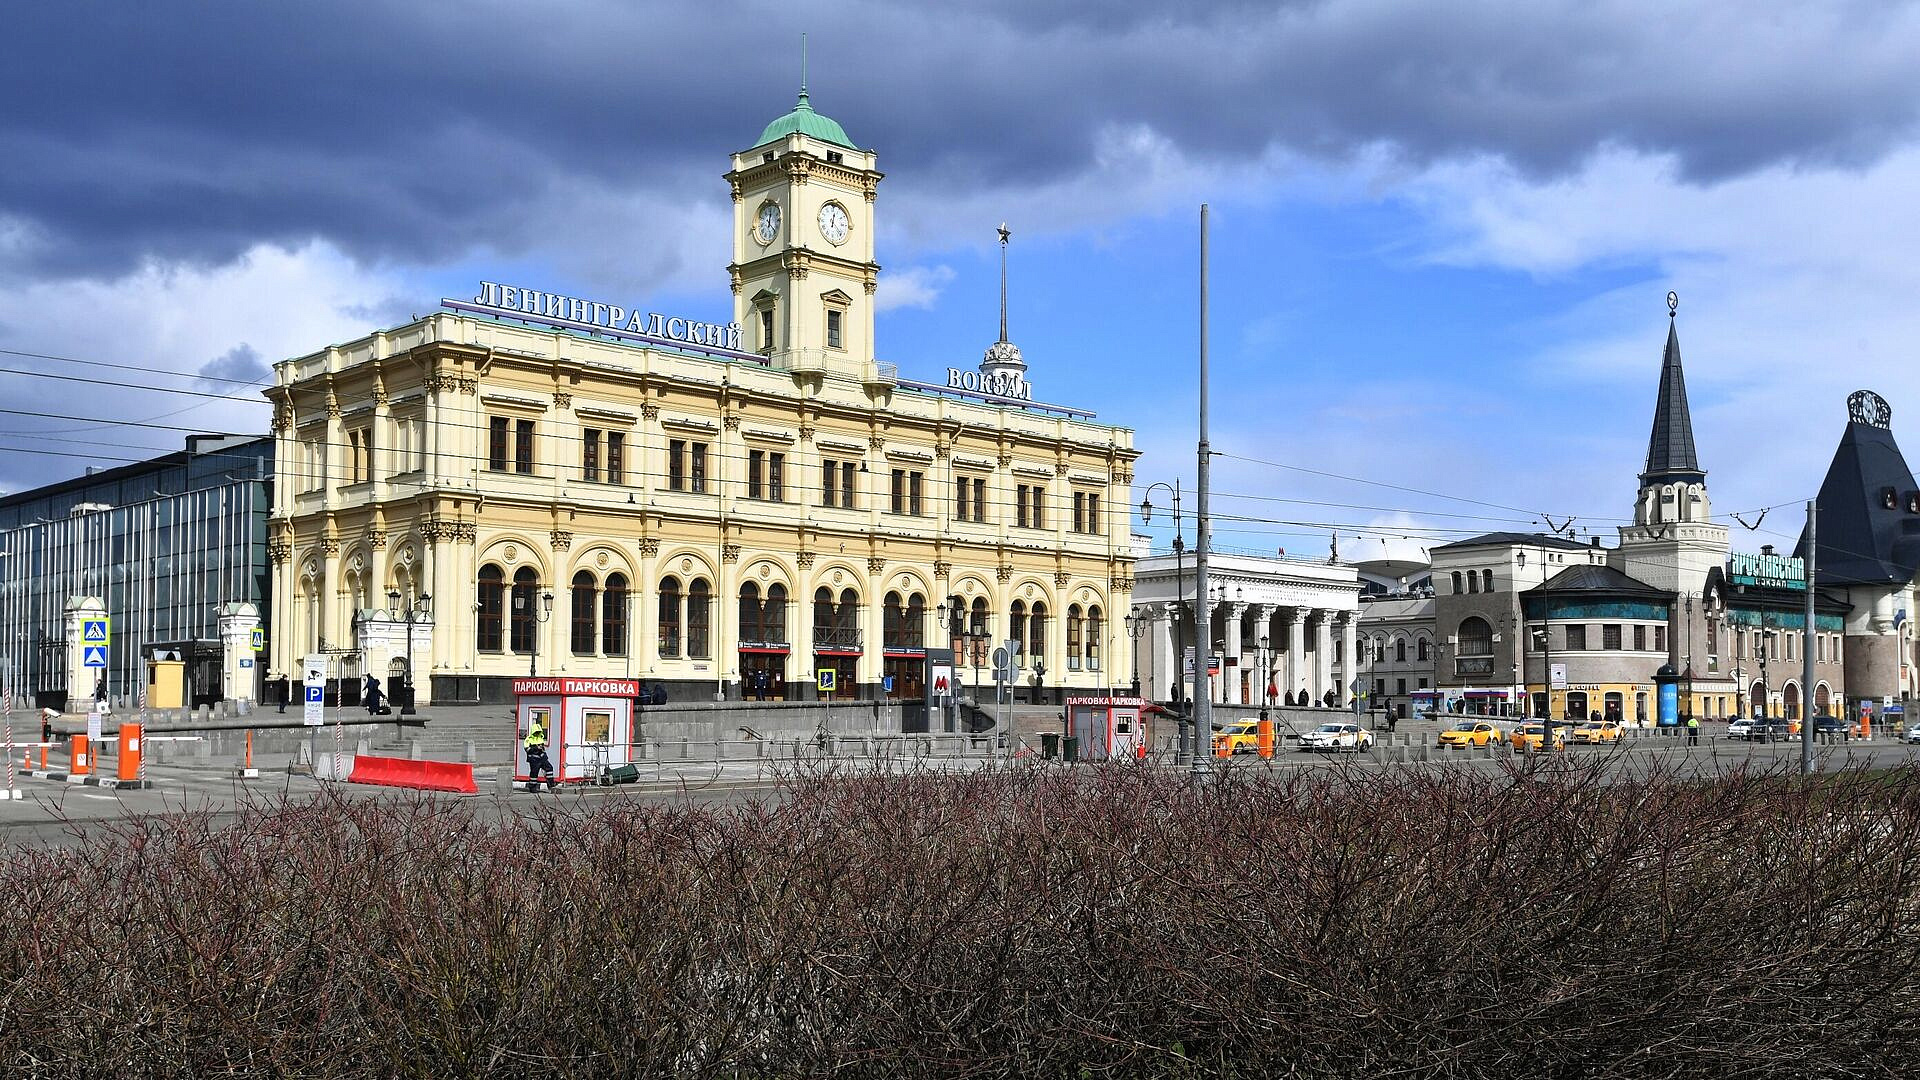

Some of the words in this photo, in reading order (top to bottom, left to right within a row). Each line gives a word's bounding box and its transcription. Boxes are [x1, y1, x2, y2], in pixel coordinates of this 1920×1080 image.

[475, 281, 744, 351] ЛЕНИНГРАДСКИЙ
[947, 368, 1032, 400] ВОКЗАЛ
[514, 681, 560, 692] ПАРКОВКА
[565, 681, 635, 694] ПАРКОВКА
[1066, 697, 1109, 705] ПАРКОВКА
[1111, 697, 1145, 705] ПАРКОВКА
